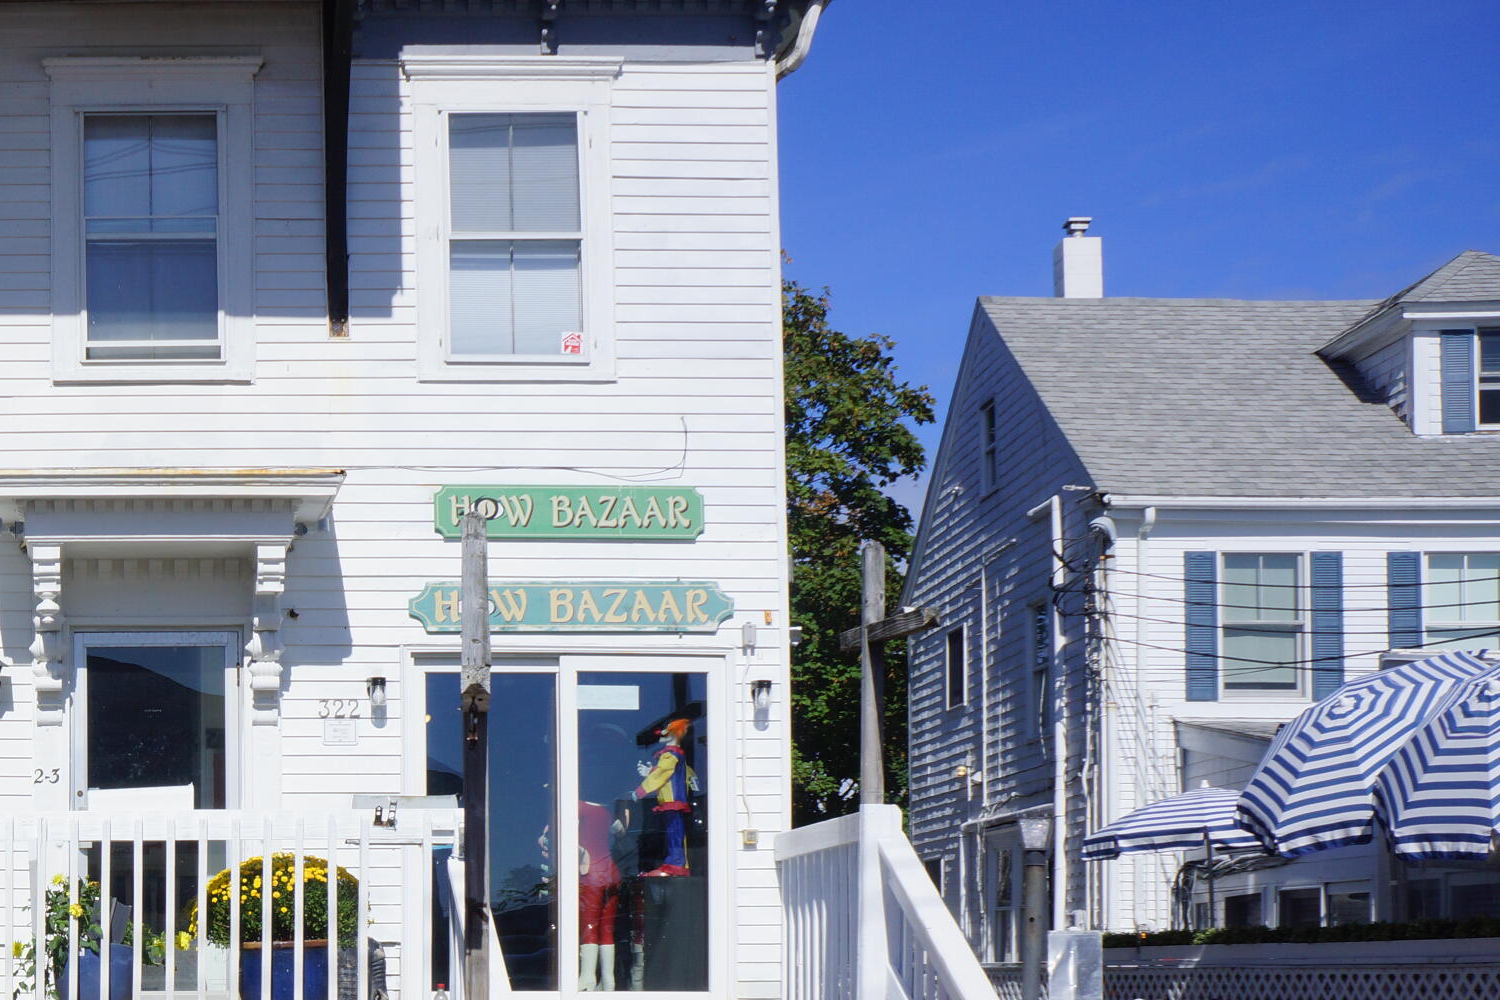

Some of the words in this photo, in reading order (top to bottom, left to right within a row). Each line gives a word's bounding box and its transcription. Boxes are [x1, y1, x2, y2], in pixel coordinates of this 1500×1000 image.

[449, 494, 535, 529] HOW
[549, 494, 692, 529] BAZAAR
[433, 588, 528, 623] HW
[549, 588, 709, 623] BAZAAR
[318, 698, 361, 719] 322
[33, 767, 61, 784] 2-3
